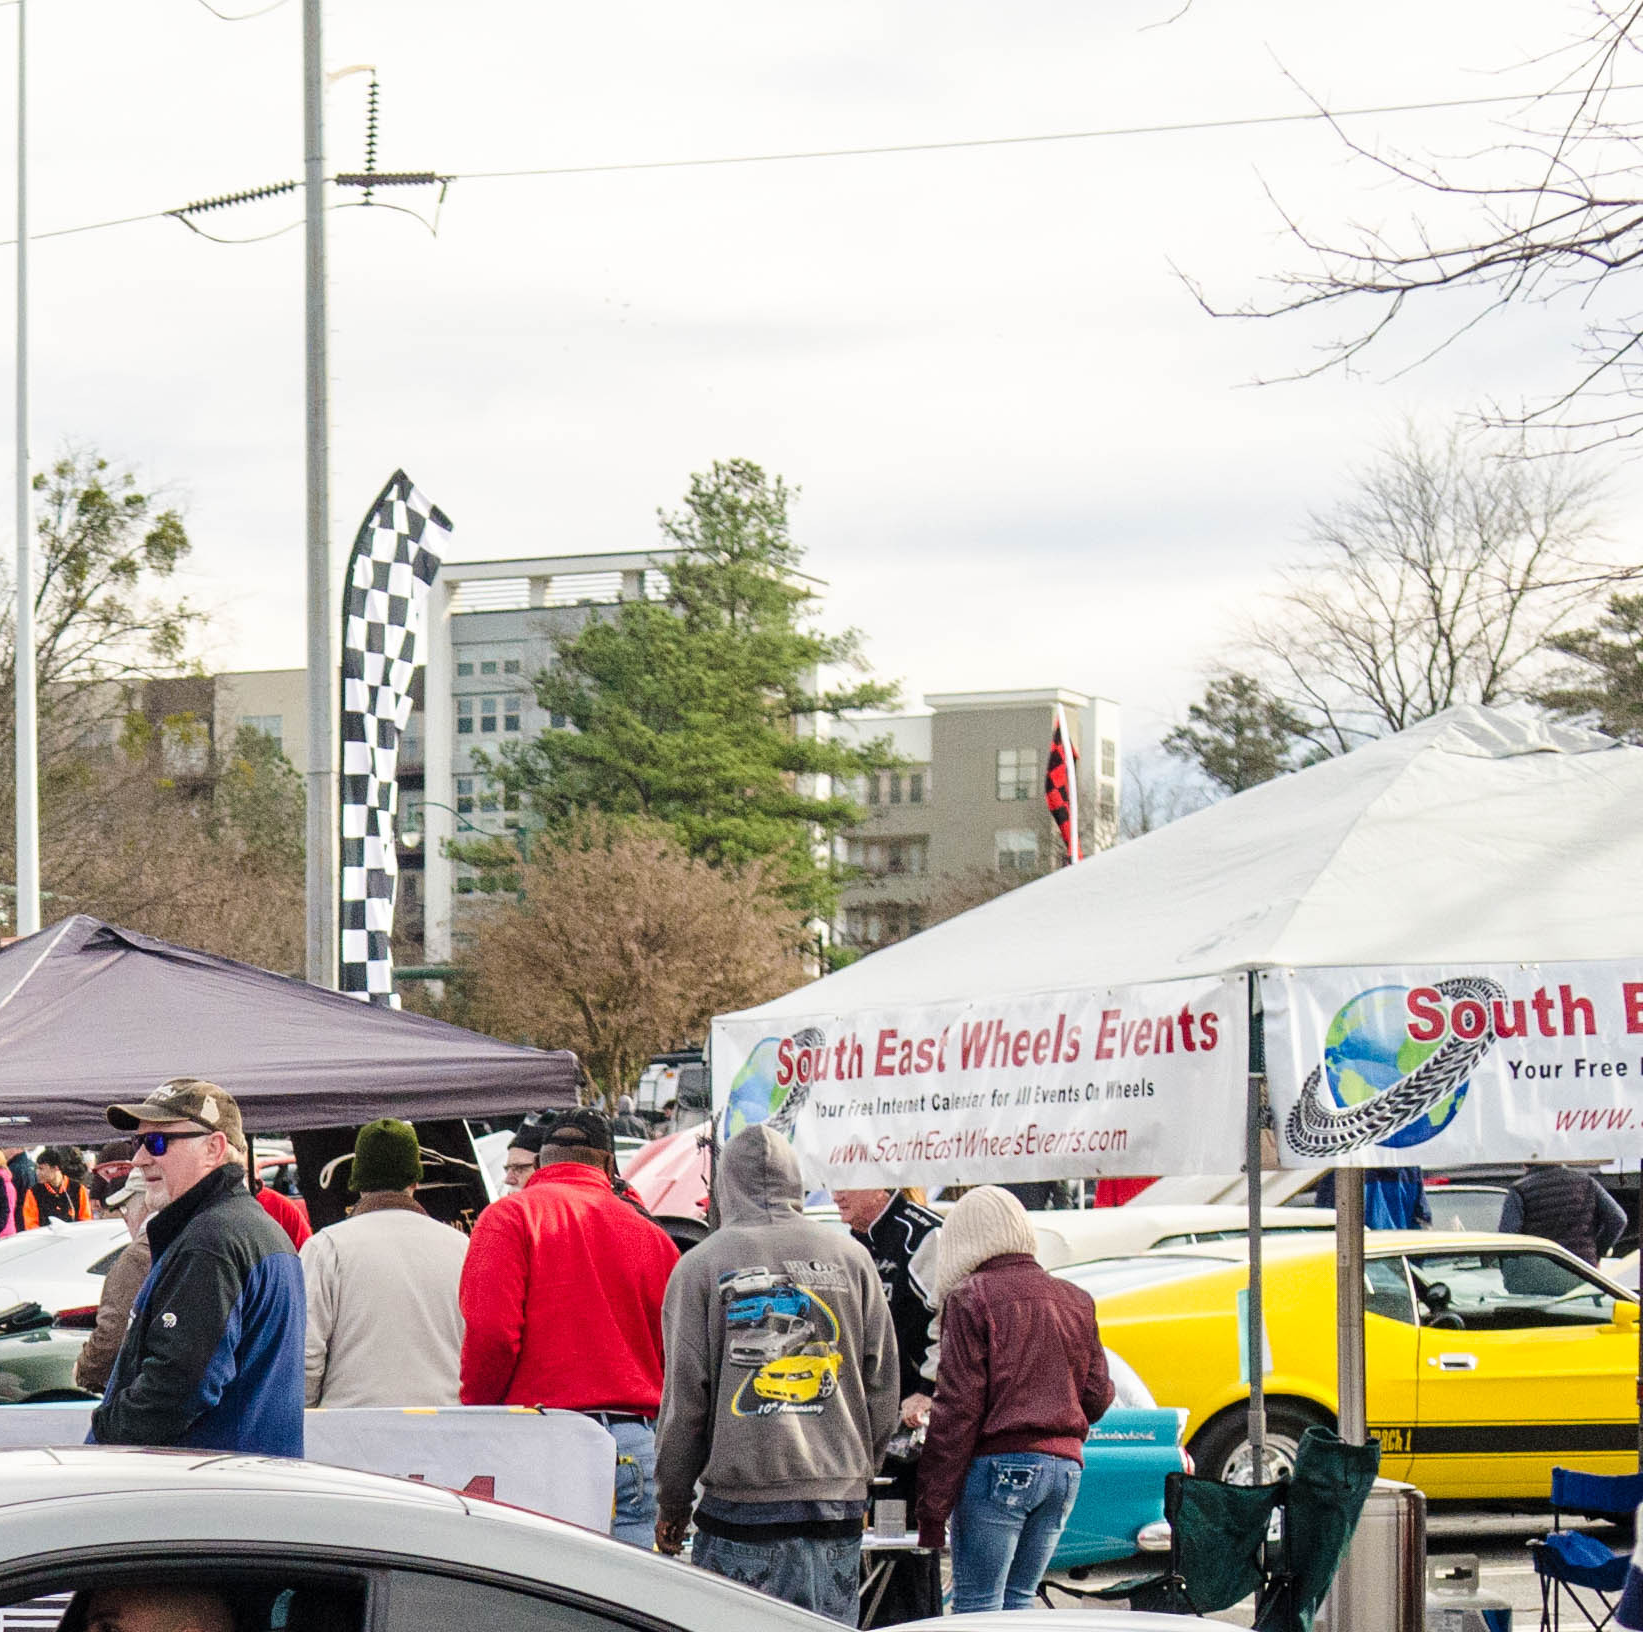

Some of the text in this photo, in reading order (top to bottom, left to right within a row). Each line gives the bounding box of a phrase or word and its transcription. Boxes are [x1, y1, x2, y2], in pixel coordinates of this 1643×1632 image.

[1407, 984, 1597, 1041] South
[776, 1000, 1219, 1087] South East Wheels Events
[1508, 1058, 1627, 1080] Your Free
[815, 1078, 1155, 1119] Your Free Internet Calendar for All Events On Wheels
[1556, 1108, 1643, 1131] www.
[829, 1124, 1127, 1165] www.SouthEastWheelsEvents.com
